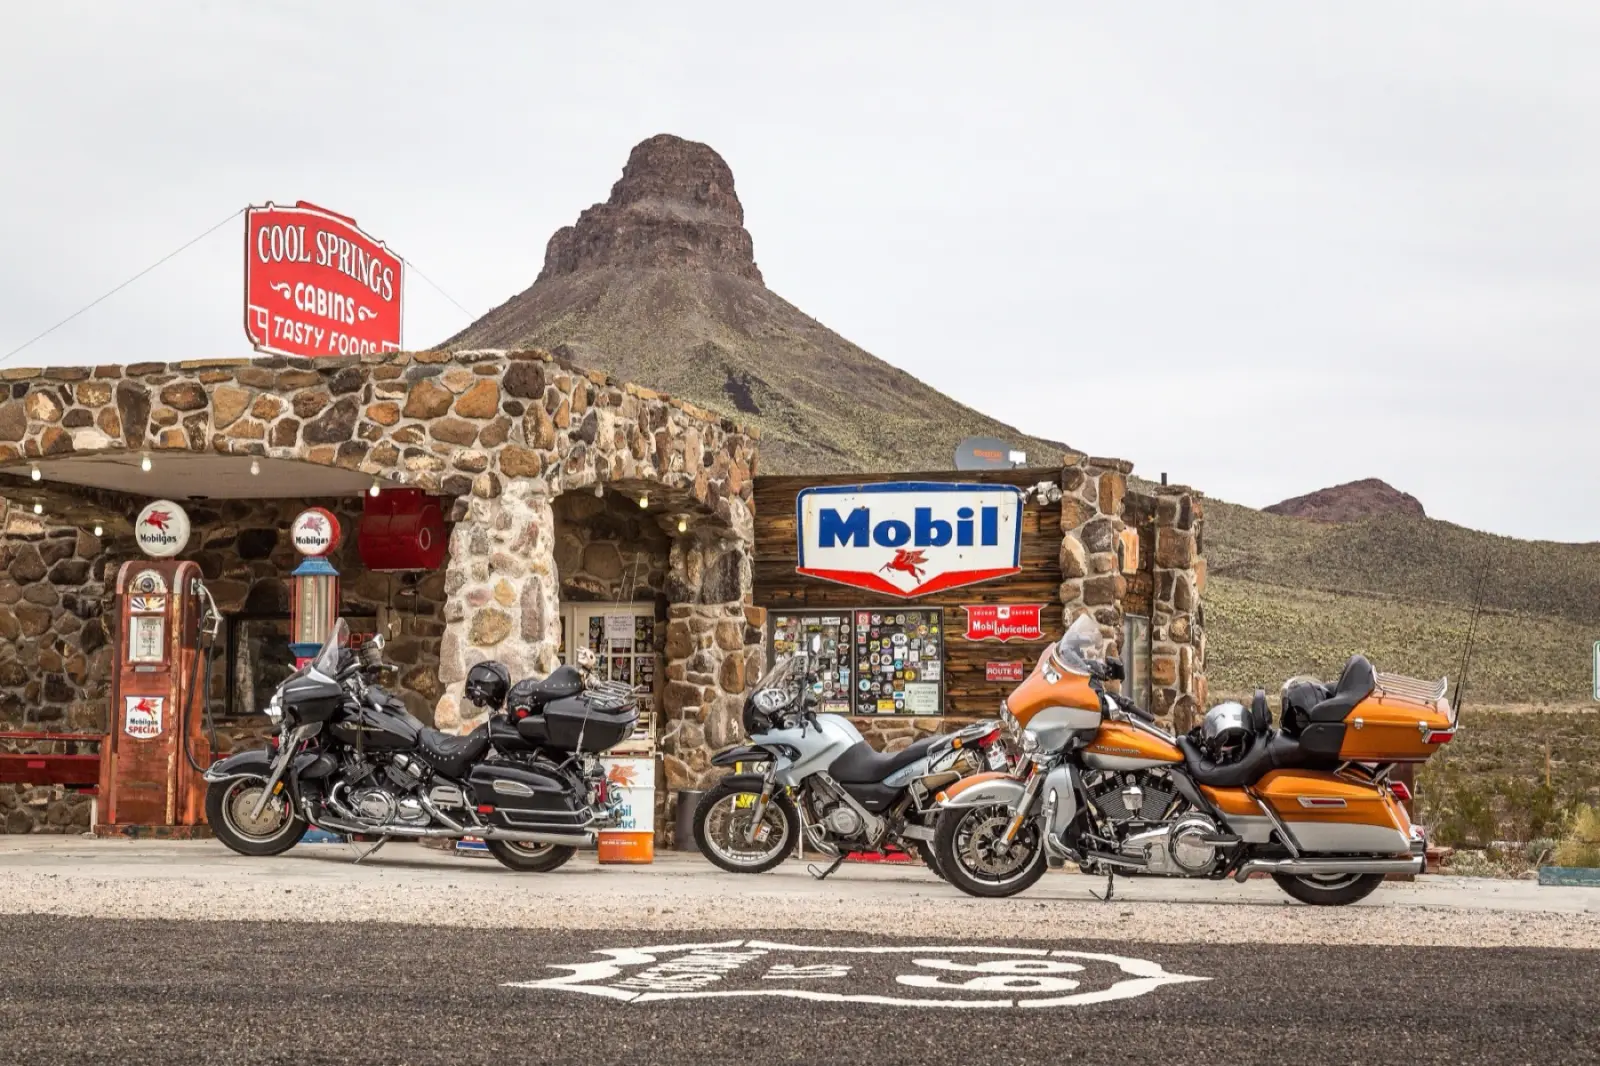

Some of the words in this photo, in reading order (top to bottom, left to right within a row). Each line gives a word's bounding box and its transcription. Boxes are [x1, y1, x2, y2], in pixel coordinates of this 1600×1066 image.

[257, 225, 312, 264] COOL
[316, 230, 394, 302] SPRINGS
[294, 282, 355, 326] CABINS
[273, 316, 325, 349] TASTY
[818, 506, 999, 548] Mobil
[140, 534, 177, 545] Mobilgas
[295, 536, 329, 546] Mobilgas
[987, 667, 1011, 675] ROUTE
[128, 726, 160, 734] SPECIAL
[761, 964, 853, 980] US
[895, 958, 1087, 992] 66
